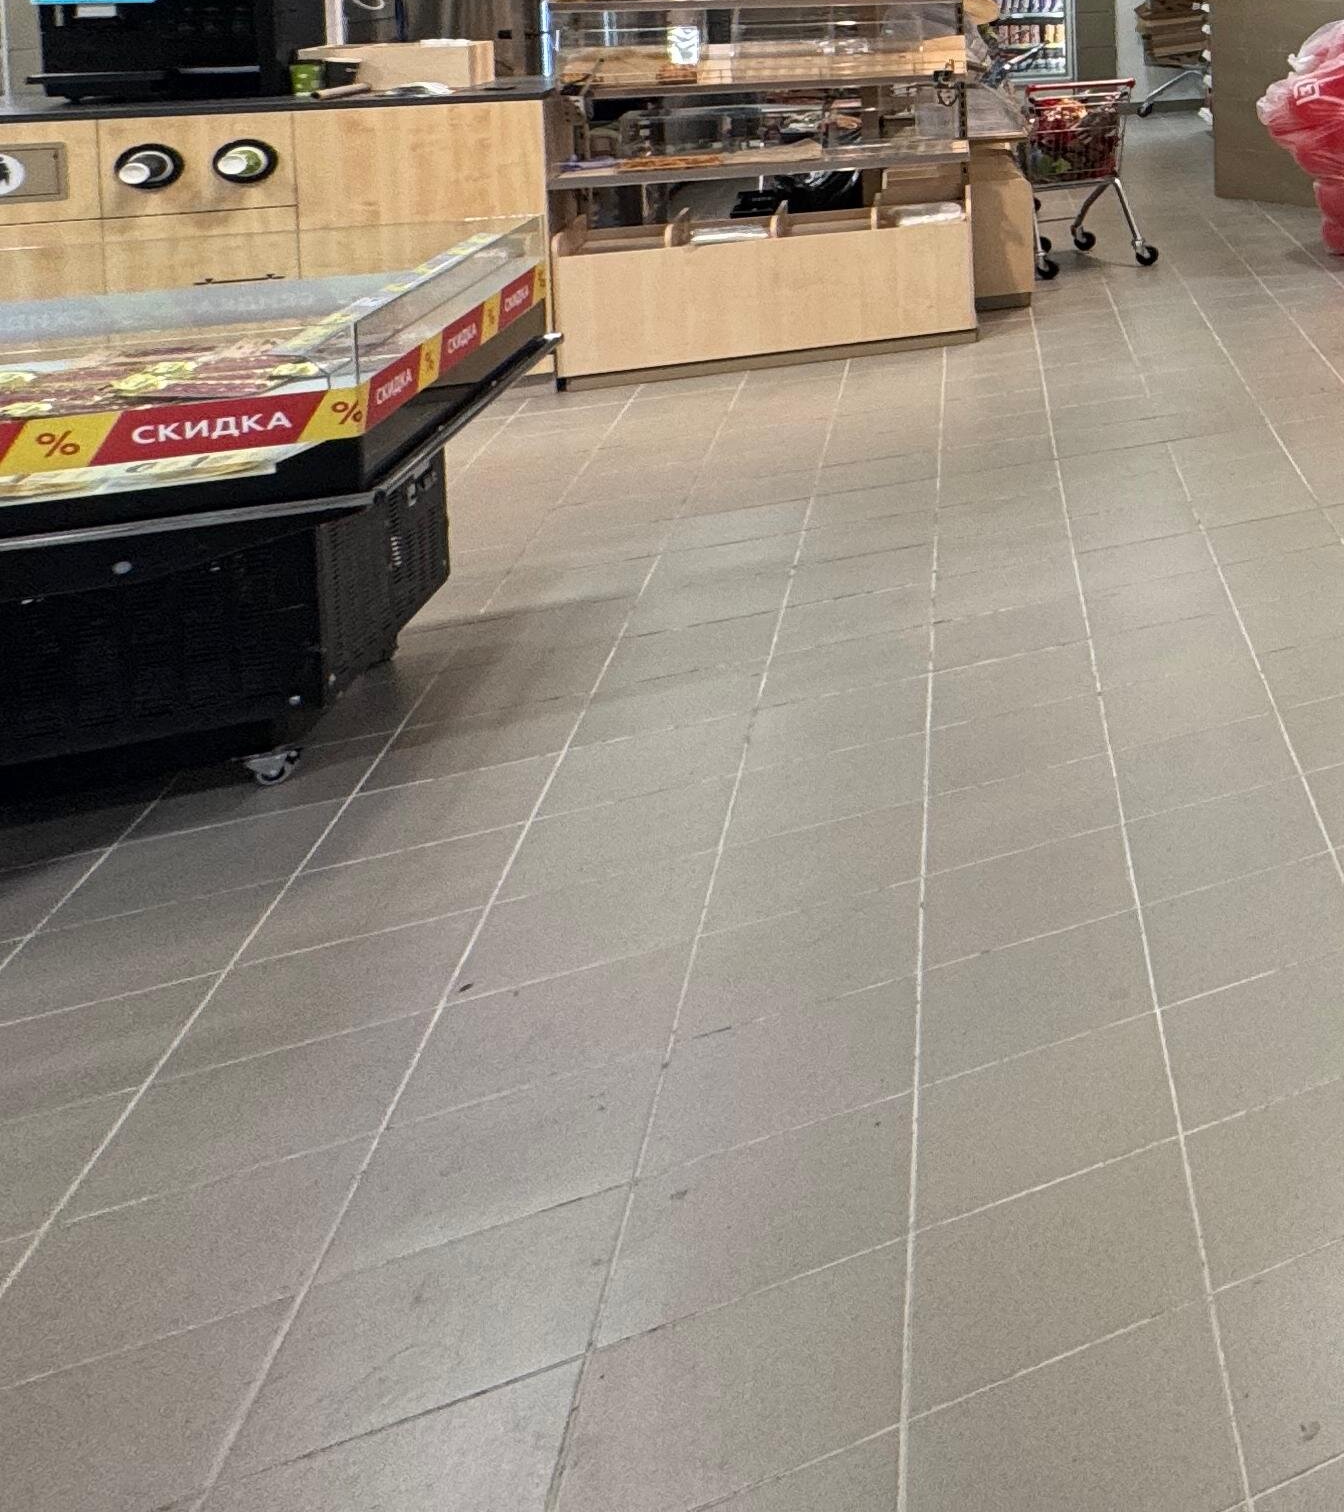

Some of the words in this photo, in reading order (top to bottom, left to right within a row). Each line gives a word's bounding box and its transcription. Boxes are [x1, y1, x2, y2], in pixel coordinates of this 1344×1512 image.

[376, 368, 413, 405] СКИДКА
[447, 322, 478, 354] СКИДКА
[131, 411, 293, 445] СКИДКА
